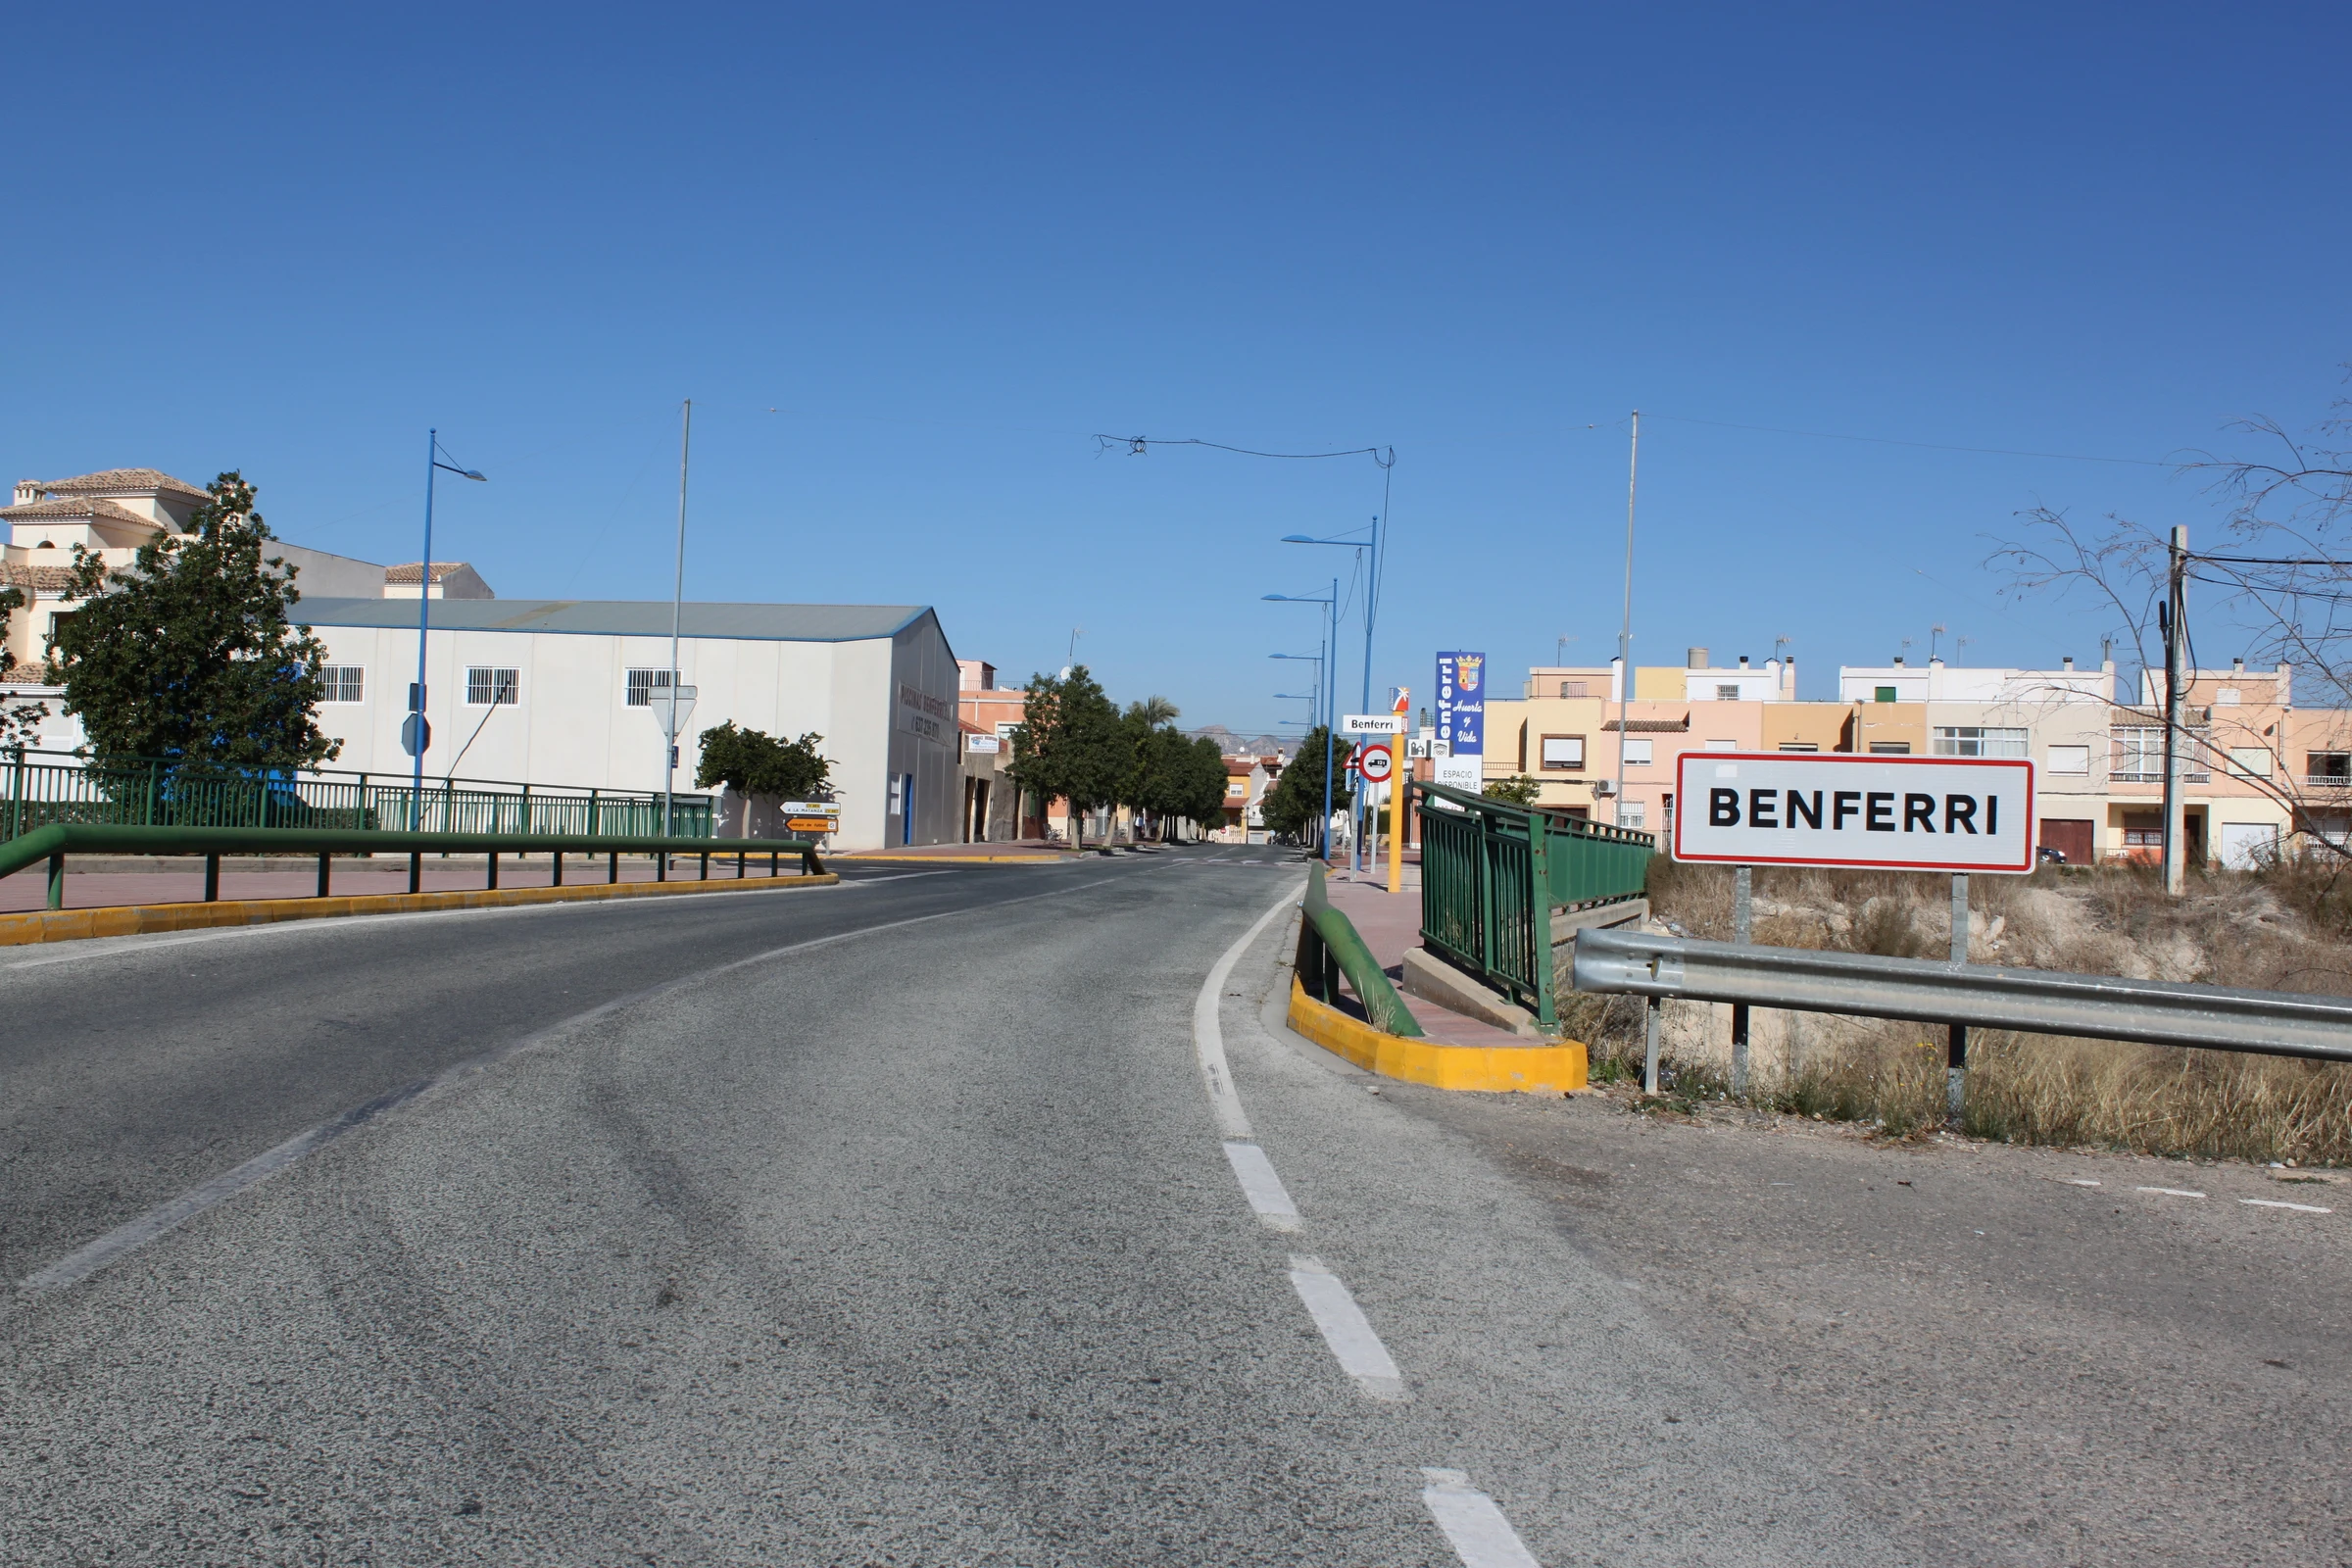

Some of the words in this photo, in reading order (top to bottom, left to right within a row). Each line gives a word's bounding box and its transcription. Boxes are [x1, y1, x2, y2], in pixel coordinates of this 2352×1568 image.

[1438, 658, 1452, 739] enferri
[1452, 700, 1483, 712] Huerta
[1351, 719, 1394, 730] Benferri
[1463, 716, 1471, 727] y
[1457, 730, 1478, 743] Vida
[1443, 770, 1473, 779] ESPACIO
[1709, 787, 1997, 835] BENFERRI
